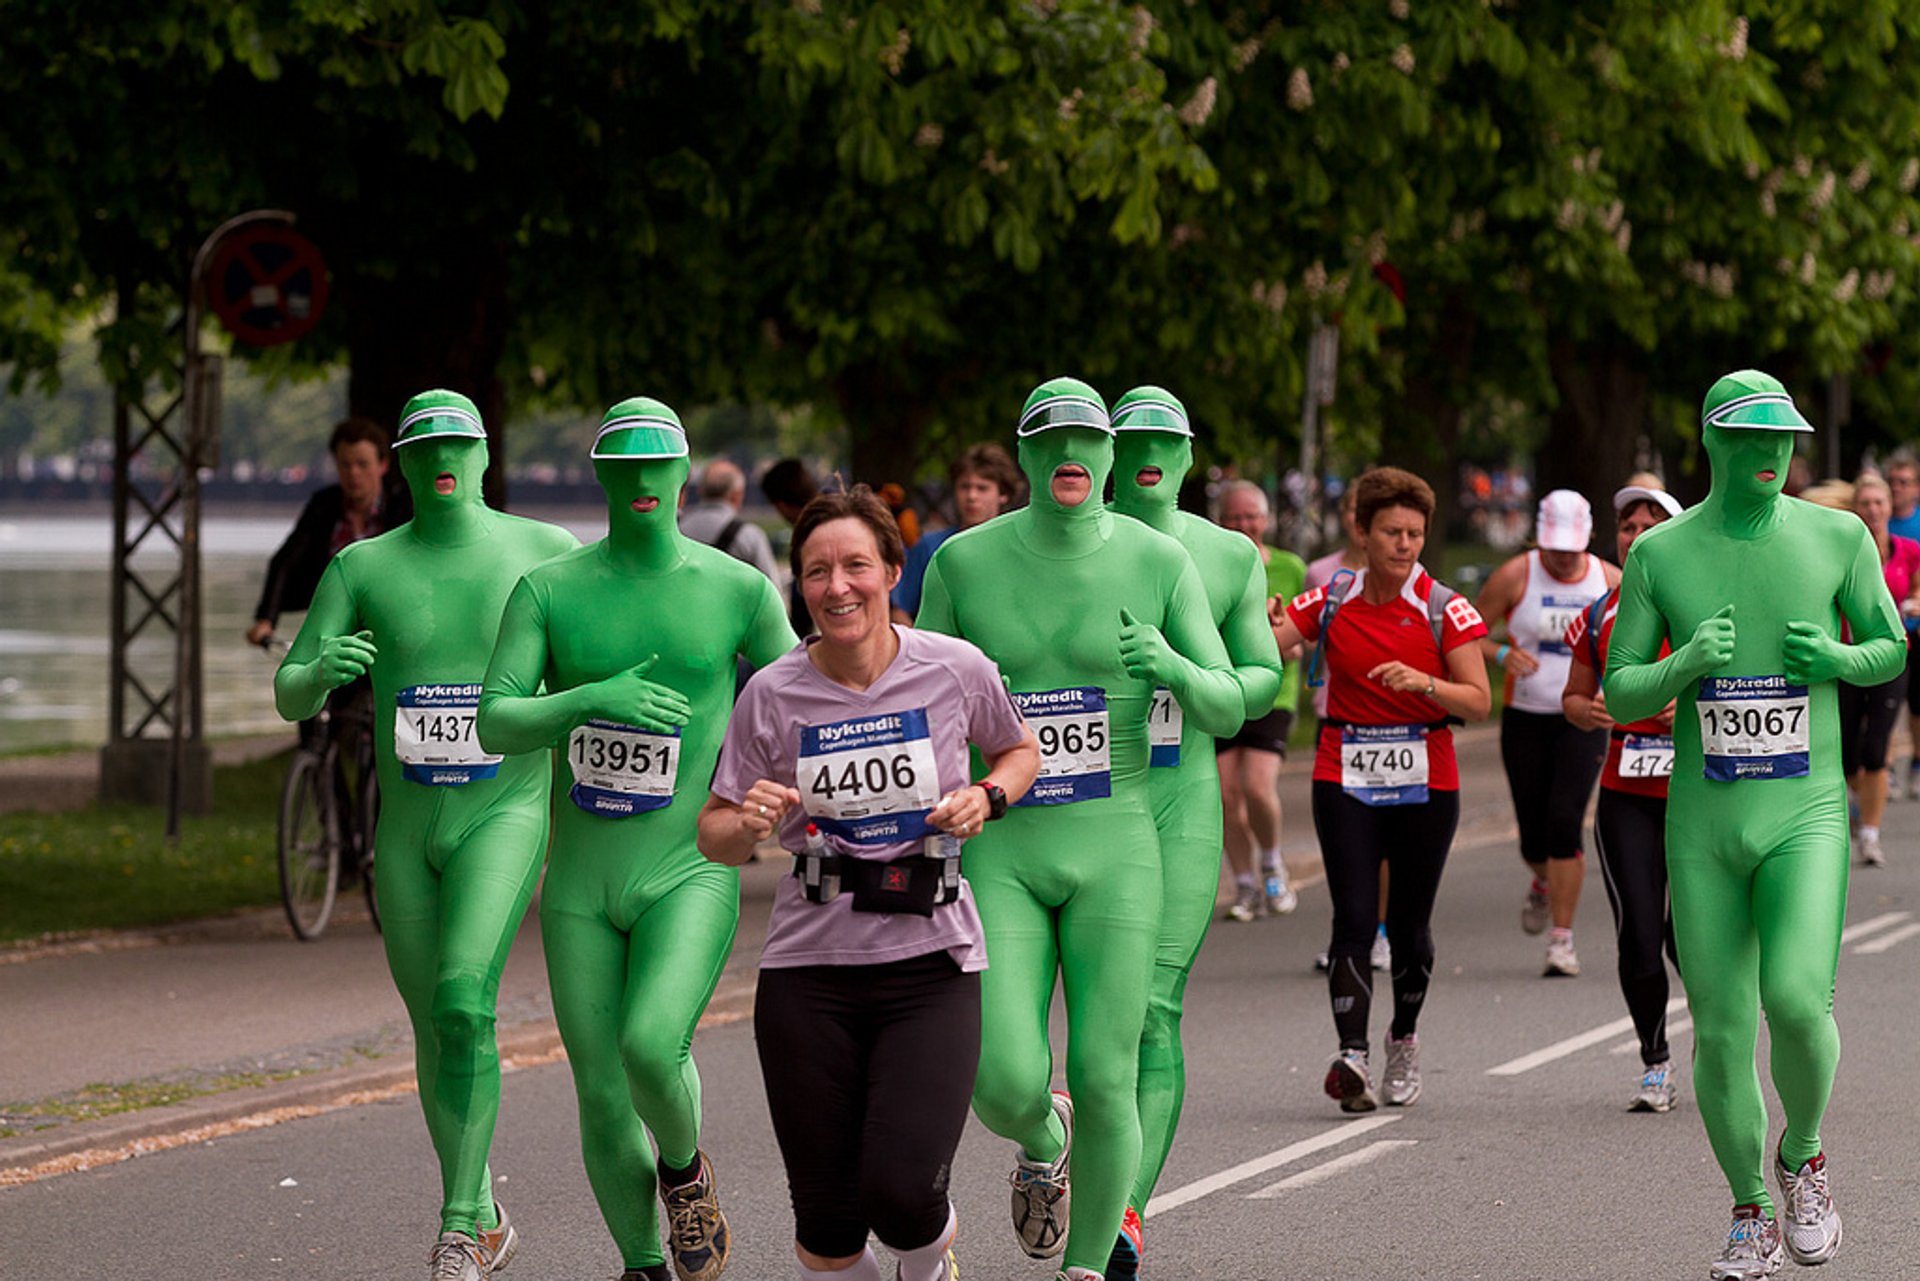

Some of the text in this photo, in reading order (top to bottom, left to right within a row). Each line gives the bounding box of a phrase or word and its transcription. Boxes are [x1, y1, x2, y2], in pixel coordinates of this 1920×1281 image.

[415, 685, 482, 698] Nykredit
[1716, 677, 1786, 690] Nykredit
[416, 715, 476, 742] 1437
[818, 716, 902, 740] Nykredit
[1704, 705, 1804, 736] 13067
[819, 737, 866, 751] Copenhagen
[1038, 722, 1104, 756] 965
[573, 733, 670, 776] 13951
[1350, 748, 1413, 772] 4740
[812, 754, 915, 799] 4406
